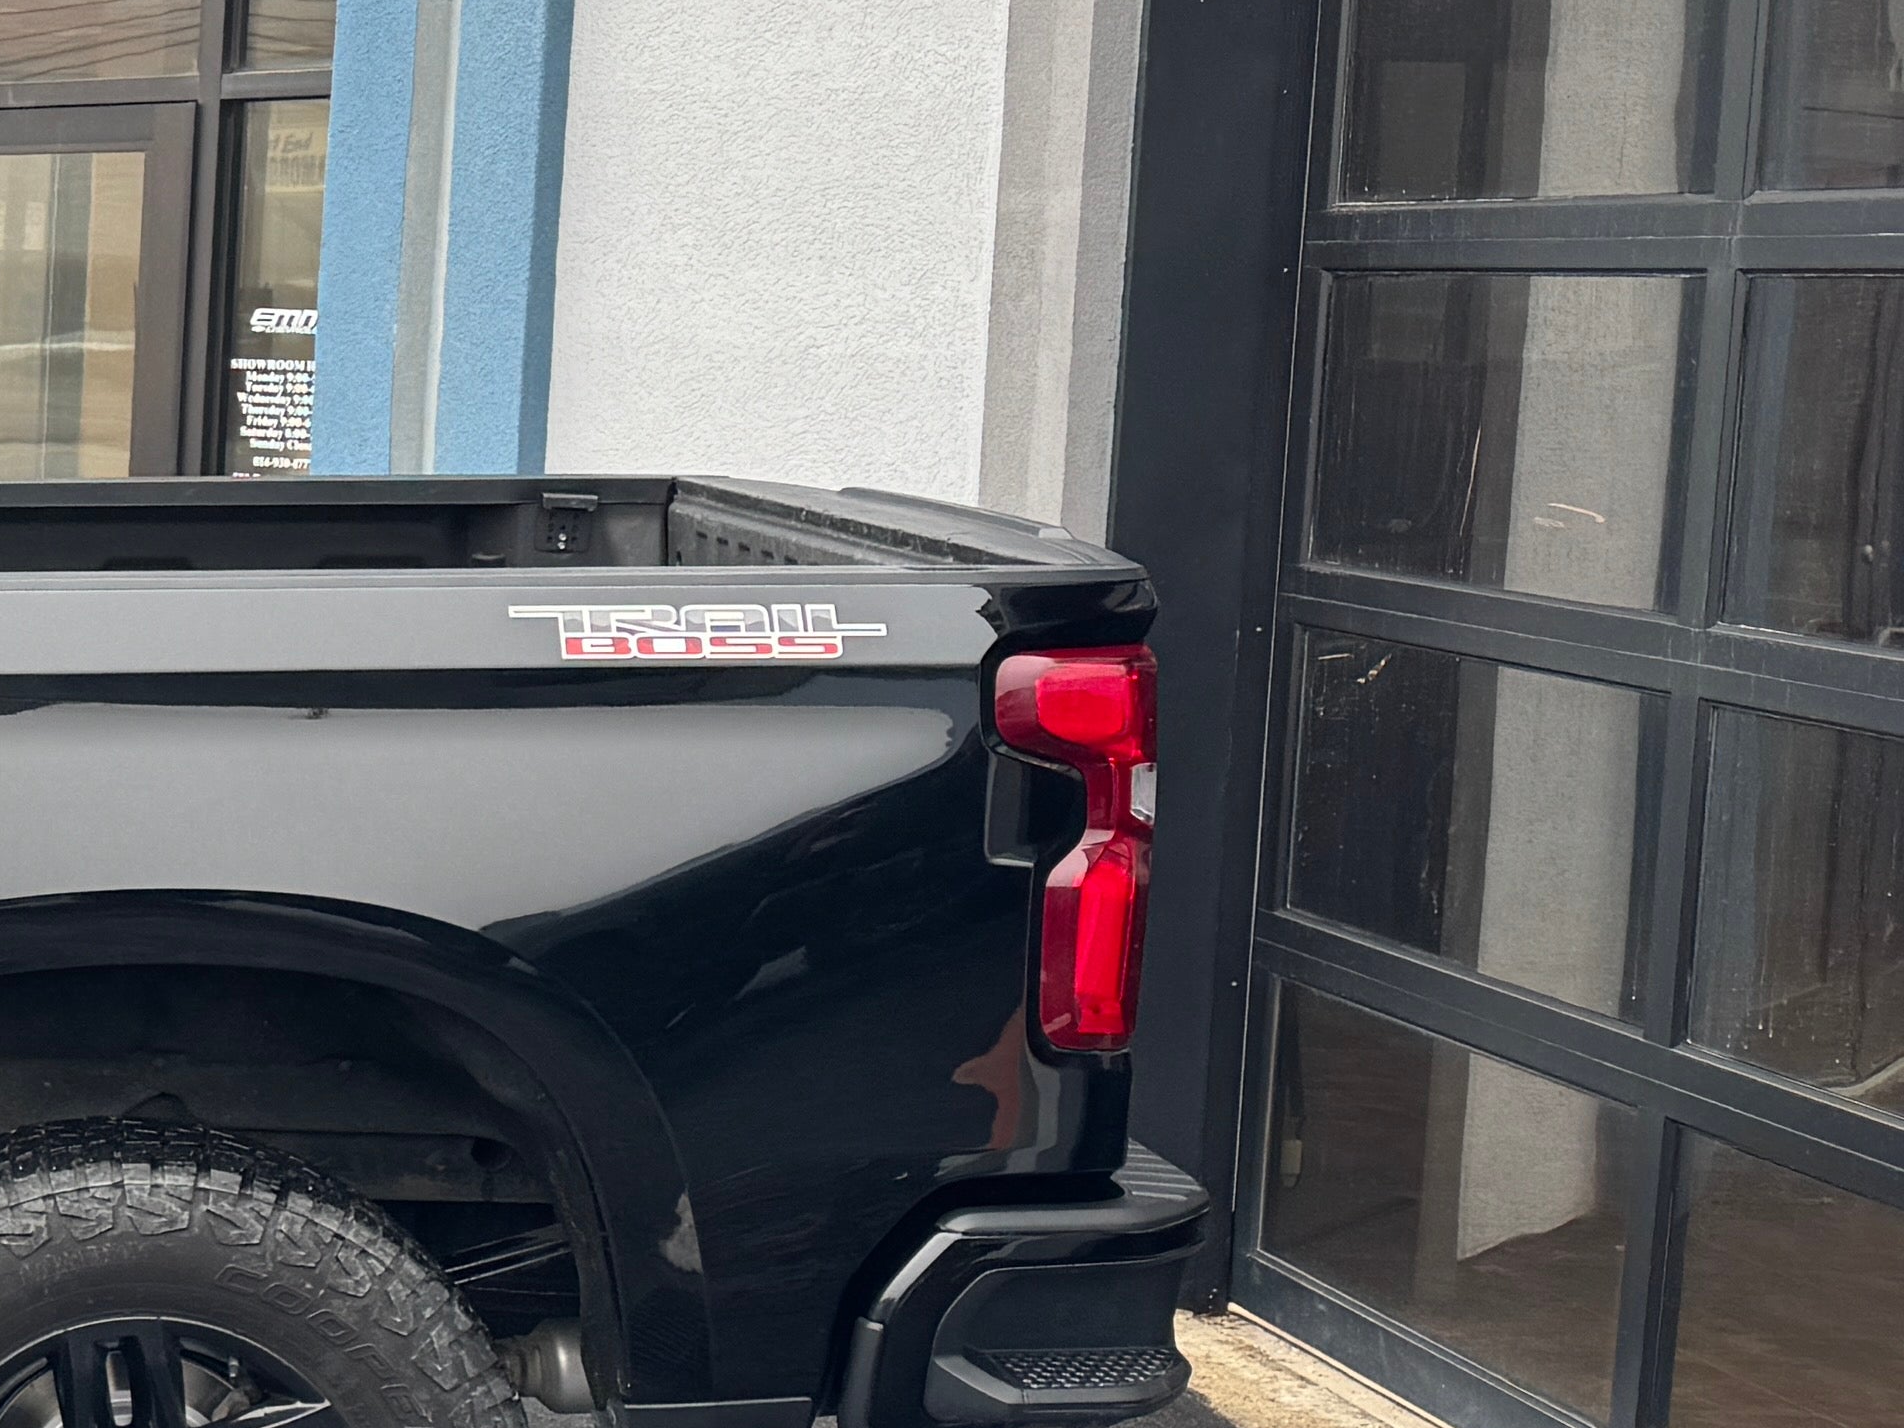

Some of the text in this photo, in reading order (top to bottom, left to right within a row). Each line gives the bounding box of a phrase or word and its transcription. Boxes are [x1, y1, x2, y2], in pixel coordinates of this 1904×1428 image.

[231, 359, 305, 370] SHOWROOM
[246, 371, 284, 384] Monday
[246, 382, 283, 398] Tuesday
[237, 392, 291, 406] Wednesday
[242, 404, 285, 417] Thursday
[247, 416, 277, 428] Friday
[240, 426, 282, 440] Saturday
[250, 439, 284, 451] Sunday
[508, 603, 888, 638] TRAIL
[561, 633, 843, 660] BOSS
